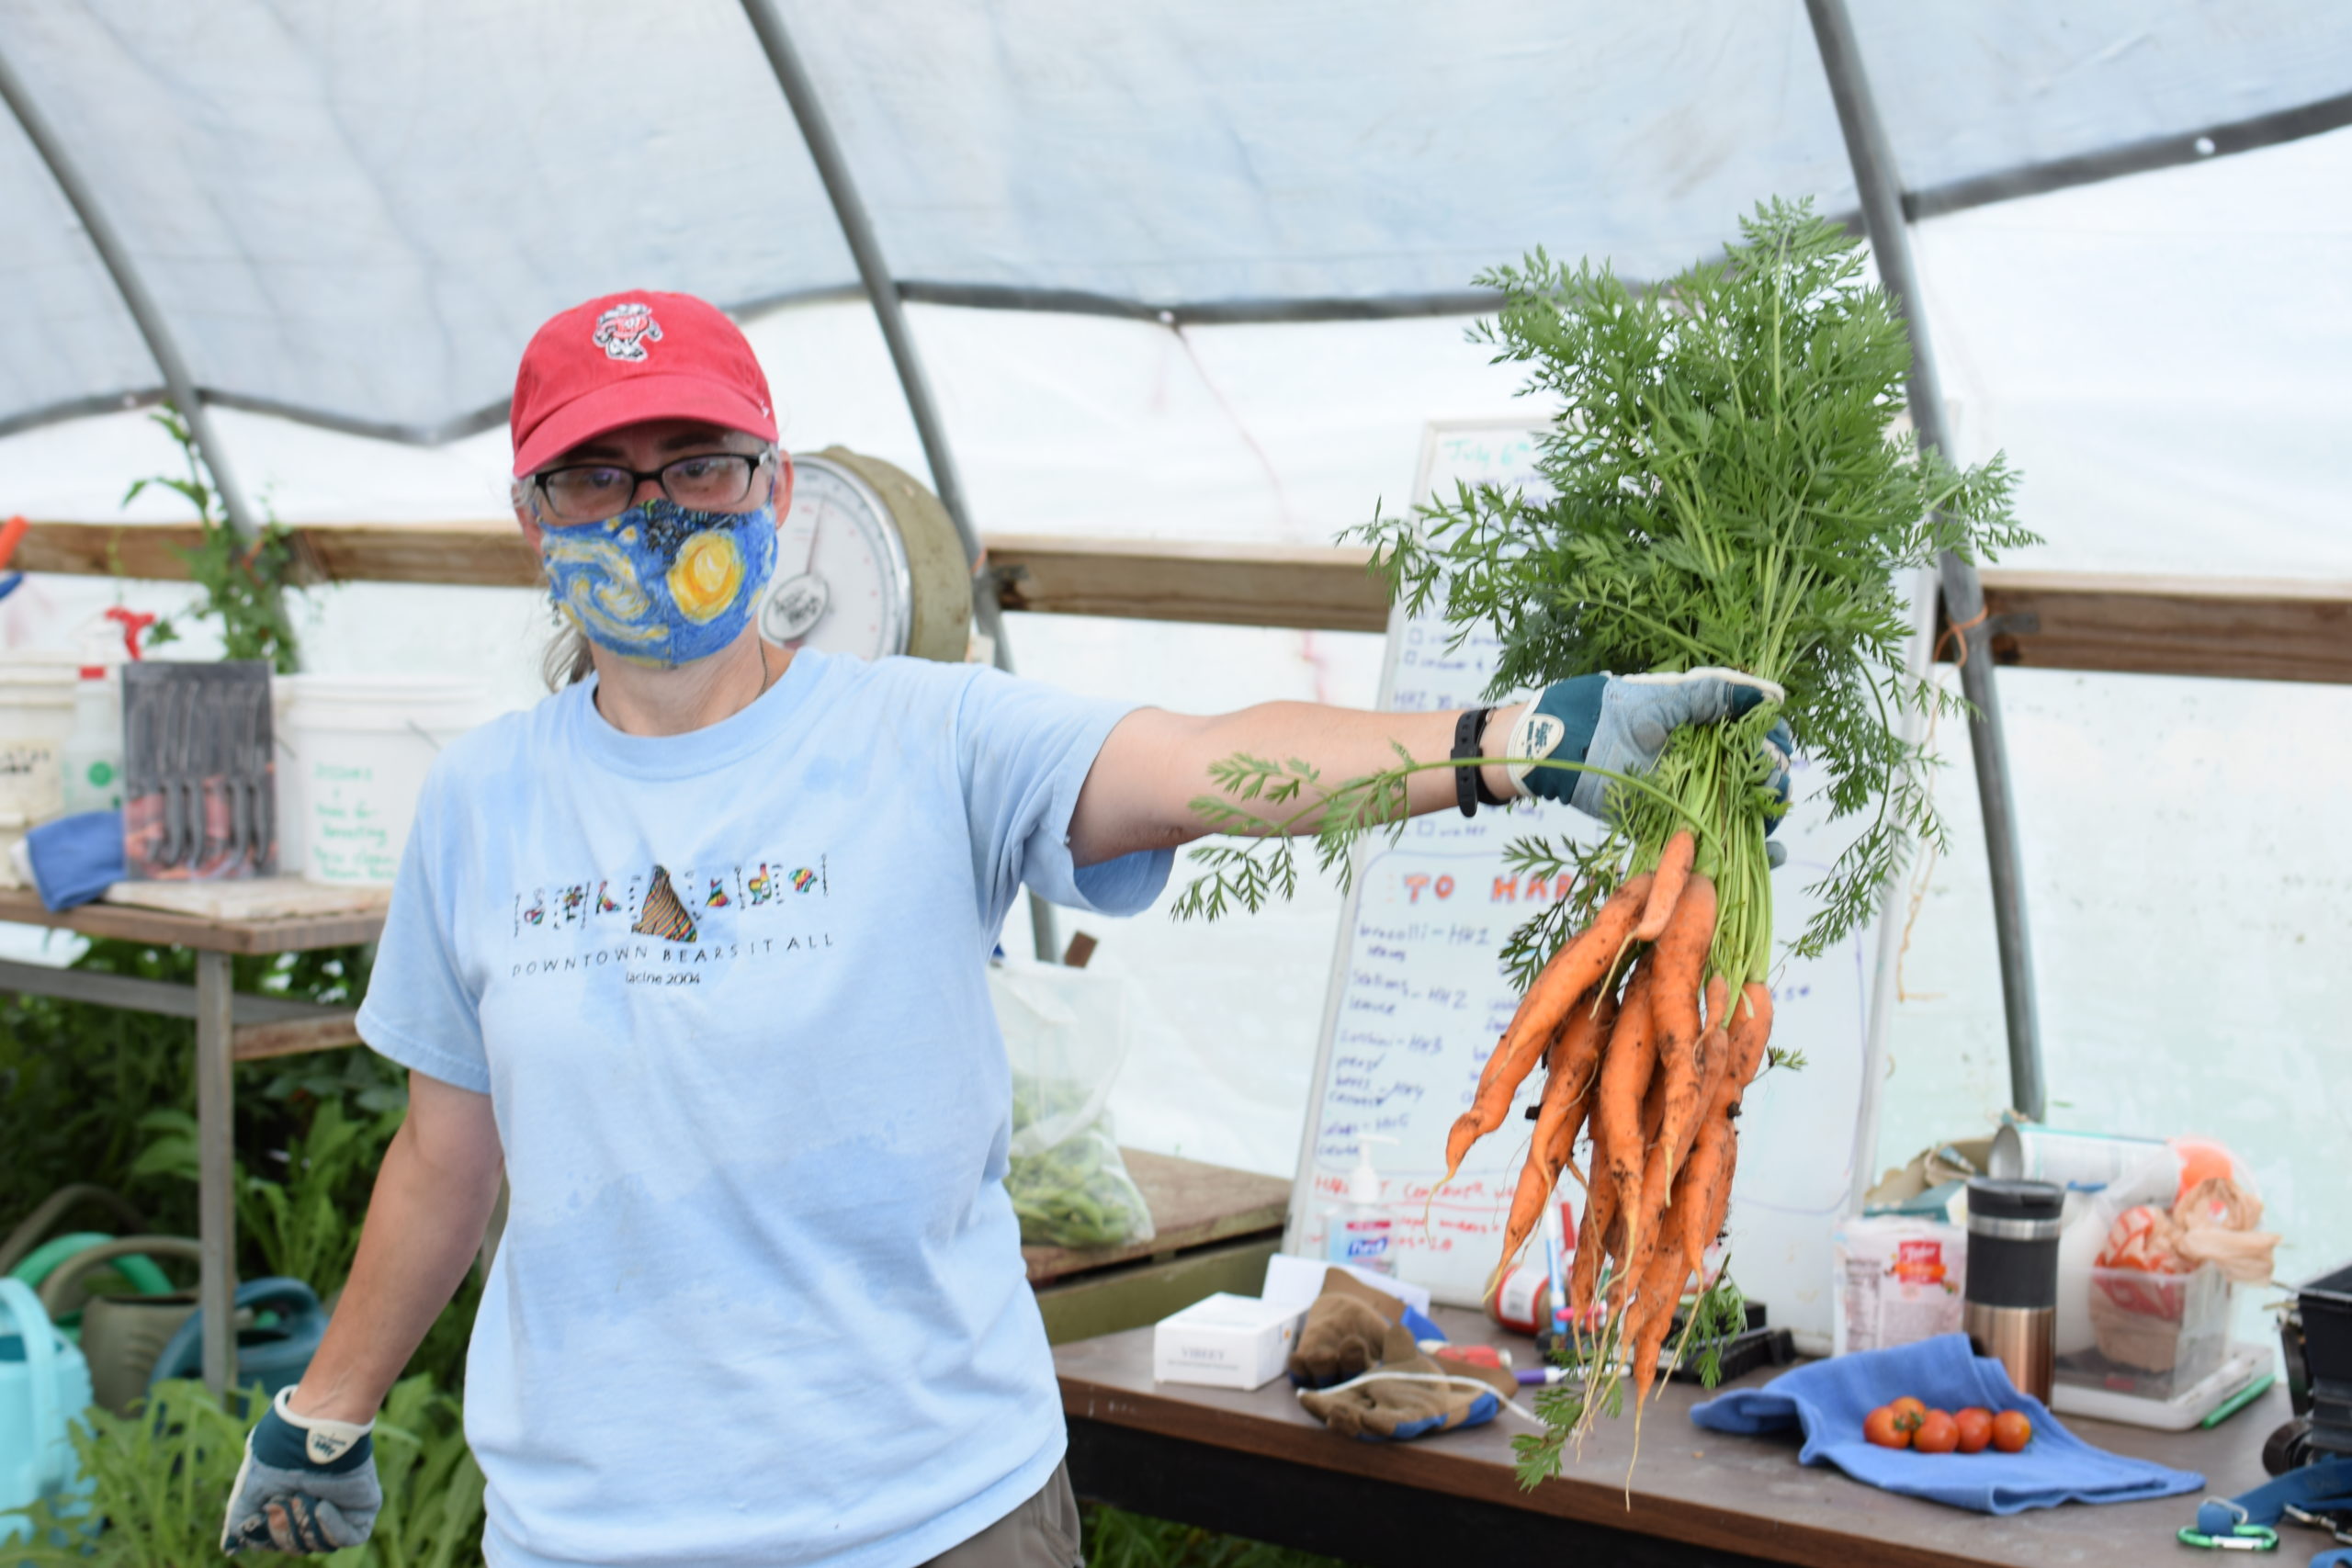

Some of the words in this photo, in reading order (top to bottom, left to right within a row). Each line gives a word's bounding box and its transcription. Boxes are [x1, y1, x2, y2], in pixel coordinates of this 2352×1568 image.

[1404, 874, 1455, 903] TO
[512, 945, 650, 978] DOWNTOWN
[662, 942, 740, 964] BEARS
[750, 938, 774, 956] IT
[786, 931, 834, 953] ALL
[665, 970, 702, 986] 2004
